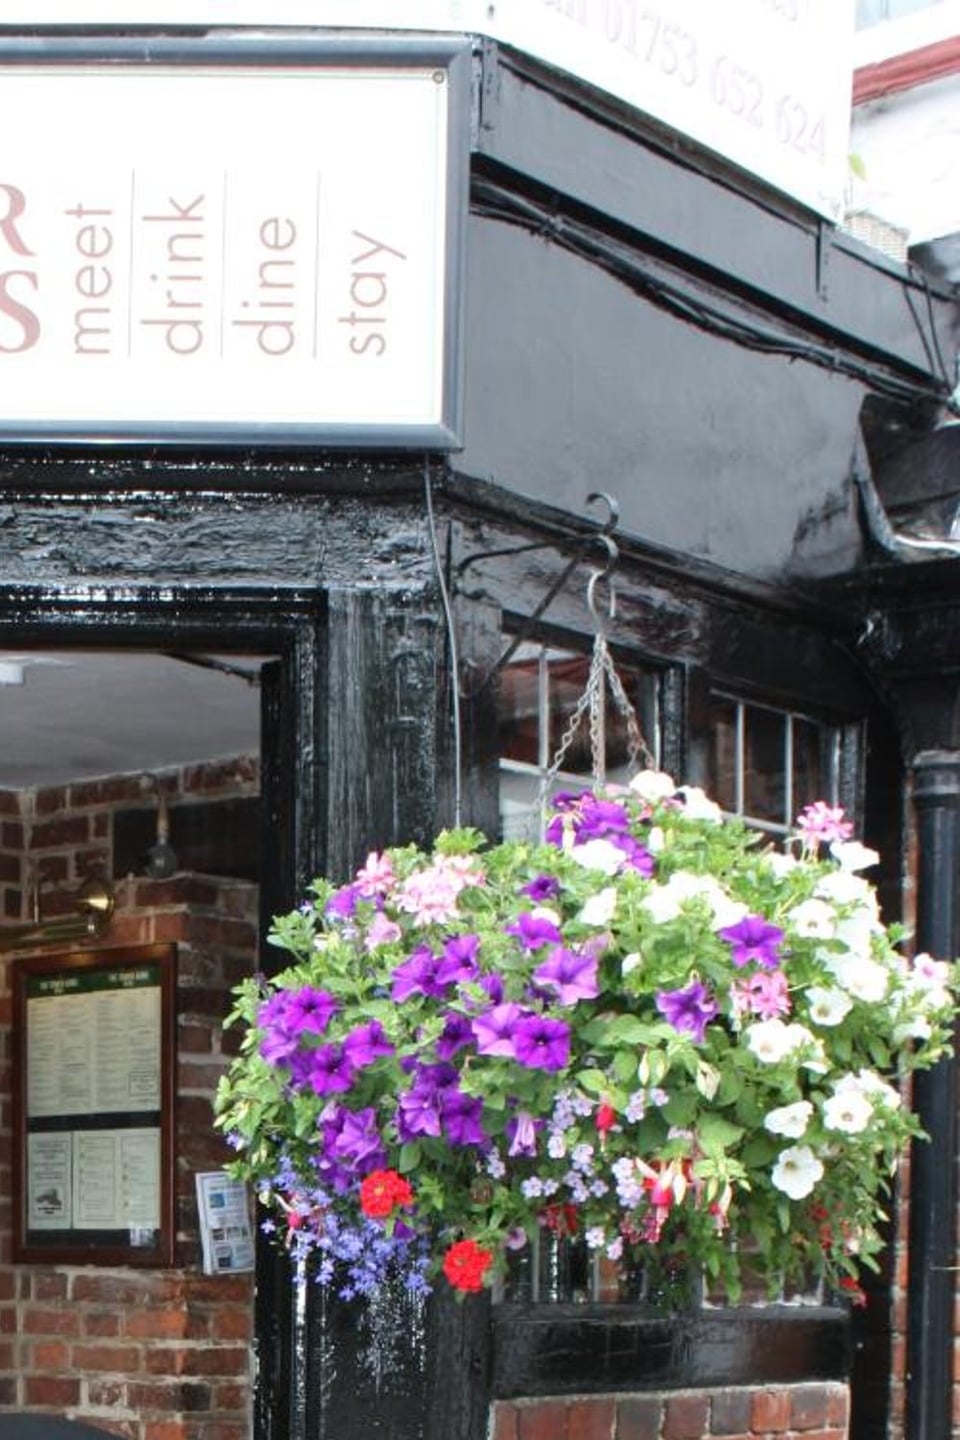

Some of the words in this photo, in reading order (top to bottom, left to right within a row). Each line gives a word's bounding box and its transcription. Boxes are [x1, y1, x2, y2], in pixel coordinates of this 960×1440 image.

[601, 0, 699, 88] 01753
[708, 55, 765, 131] 652
[774, 94, 827, 167] 624
[65, 201, 112, 357] meet
[141, 193, 206, 357] drink
[231, 215, 296, 357] dine
[337, 229, 408, 357] stay
